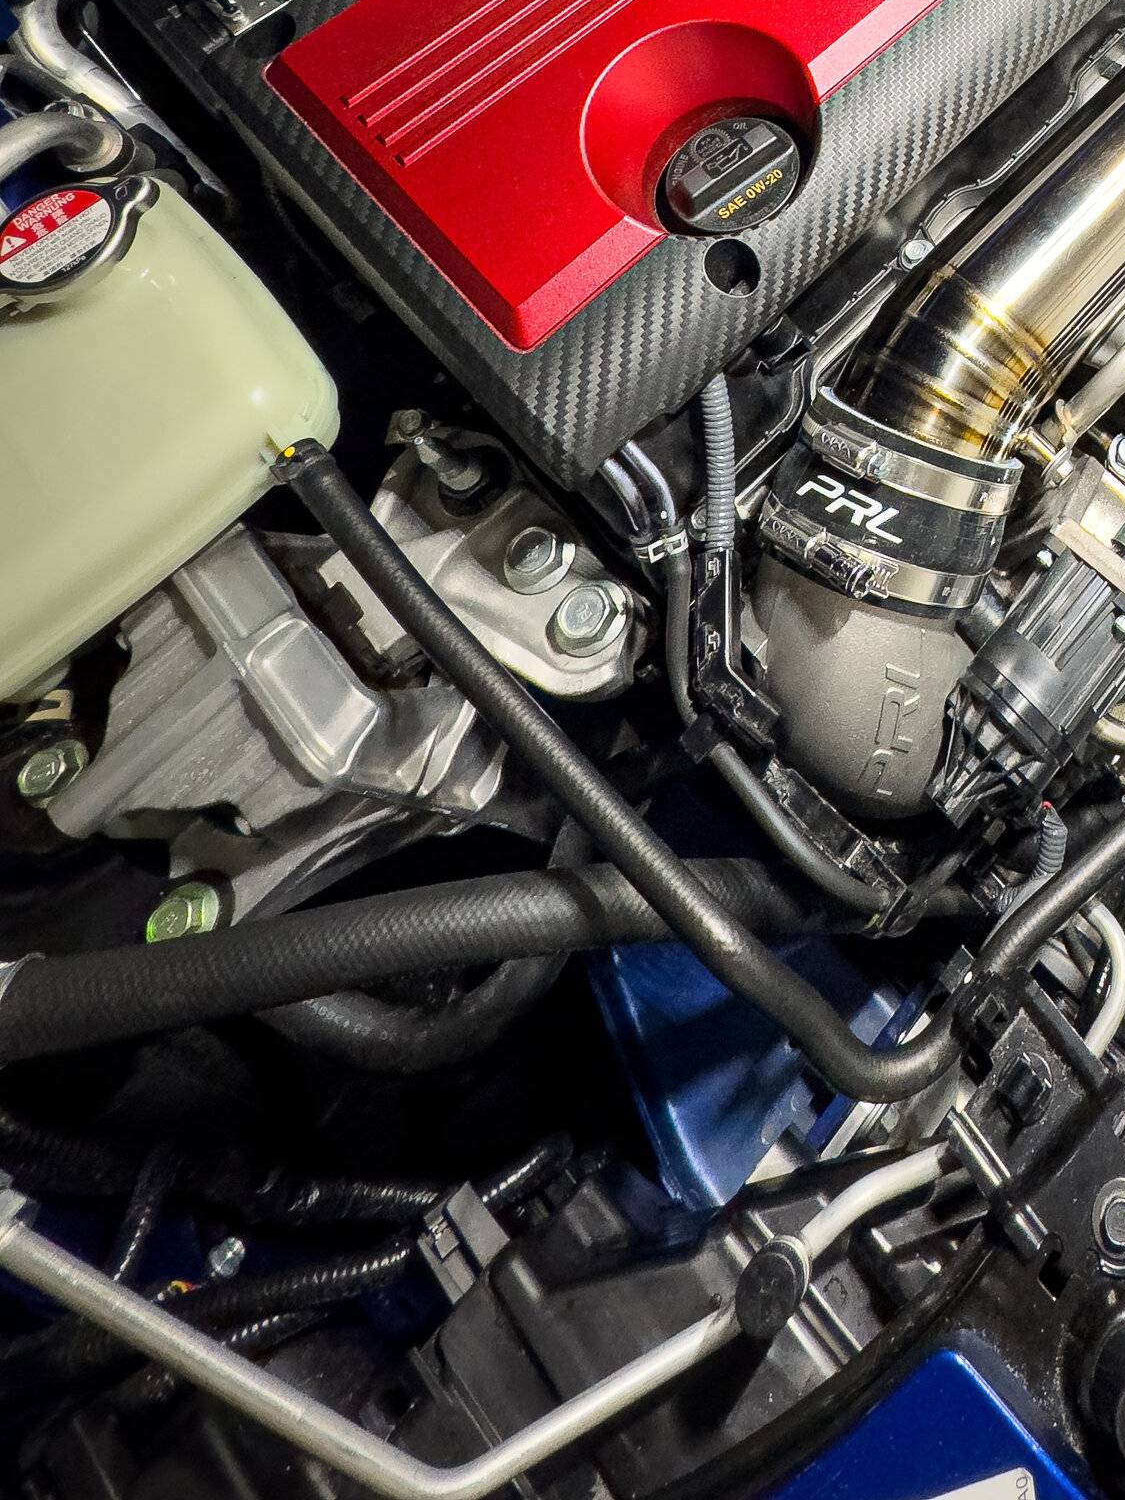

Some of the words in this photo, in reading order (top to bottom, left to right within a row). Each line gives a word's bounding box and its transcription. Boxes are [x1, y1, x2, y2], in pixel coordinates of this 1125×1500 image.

[733, 122, 749, 130] OIL
[13, 193, 60, 225] DANGER
[18, 192, 75, 231] WARNUNG
[718, 195, 747, 220] SAE
[745, 168, 783, 199] 0W-20
[796, 474, 903, 544] PRL
